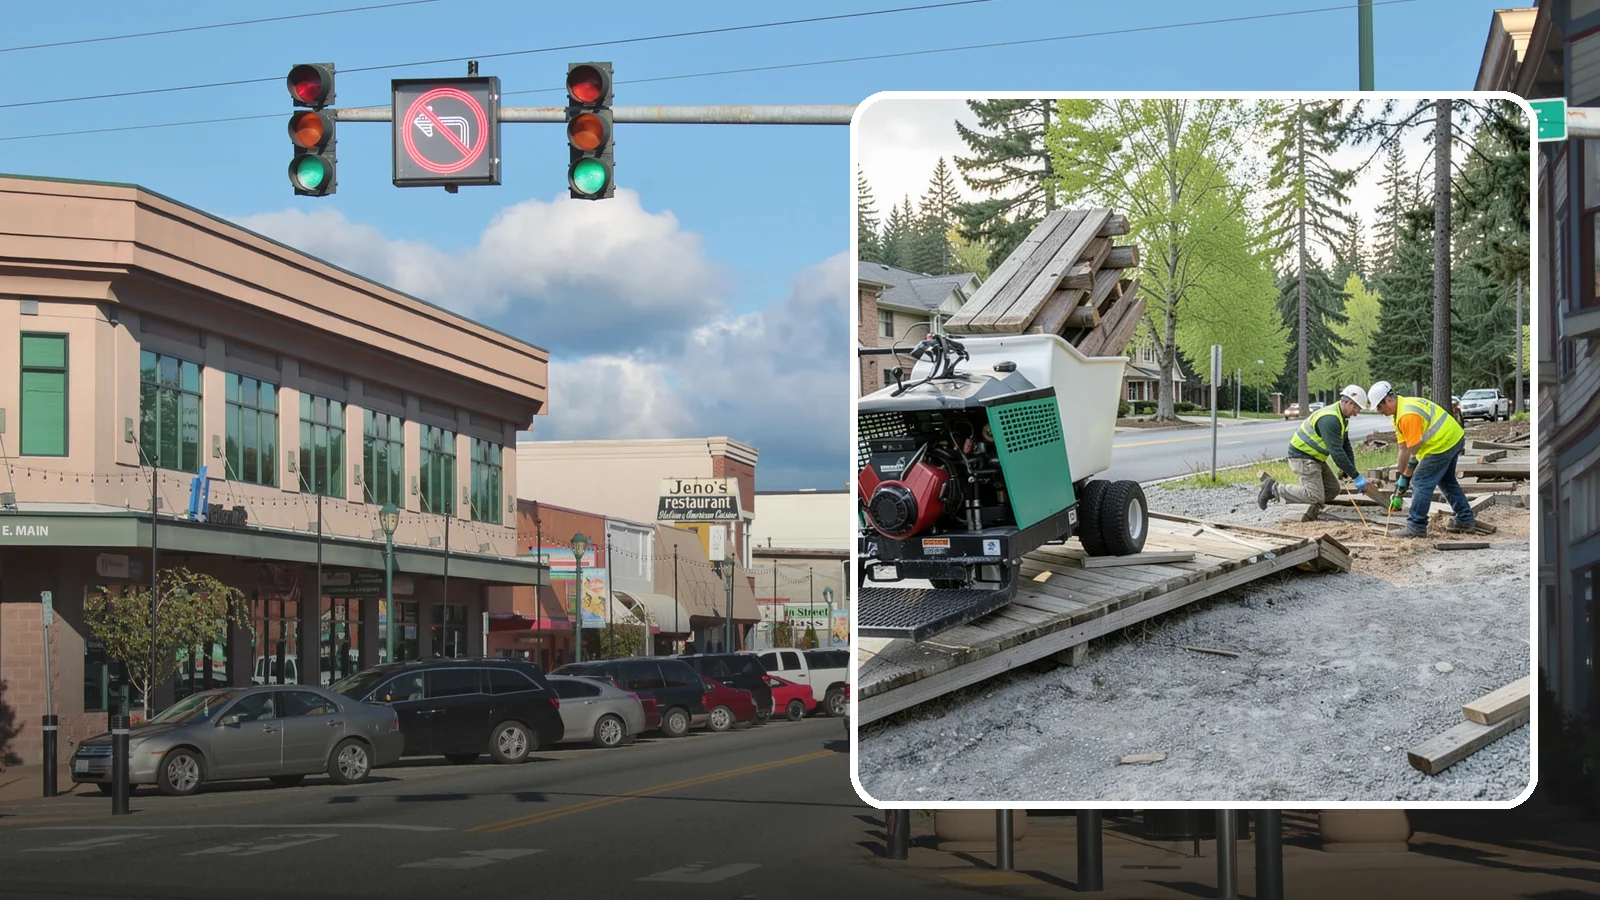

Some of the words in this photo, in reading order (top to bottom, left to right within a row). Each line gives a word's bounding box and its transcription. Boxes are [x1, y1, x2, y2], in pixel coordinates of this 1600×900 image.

[669, 480, 728, 495] Jeno's
[665, 496, 731, 509] restaurant
[658, 510, 681, 520] Italian
[686, 509, 715, 519] American
[715, 509, 738, 519] Cuisine
[2, 525, 13, 536] E.
[15, 525, 49, 536] MAIN
[786, 607, 795, 617] in
[797, 608, 828, 617] Street
[791, 619, 823, 627] lass
